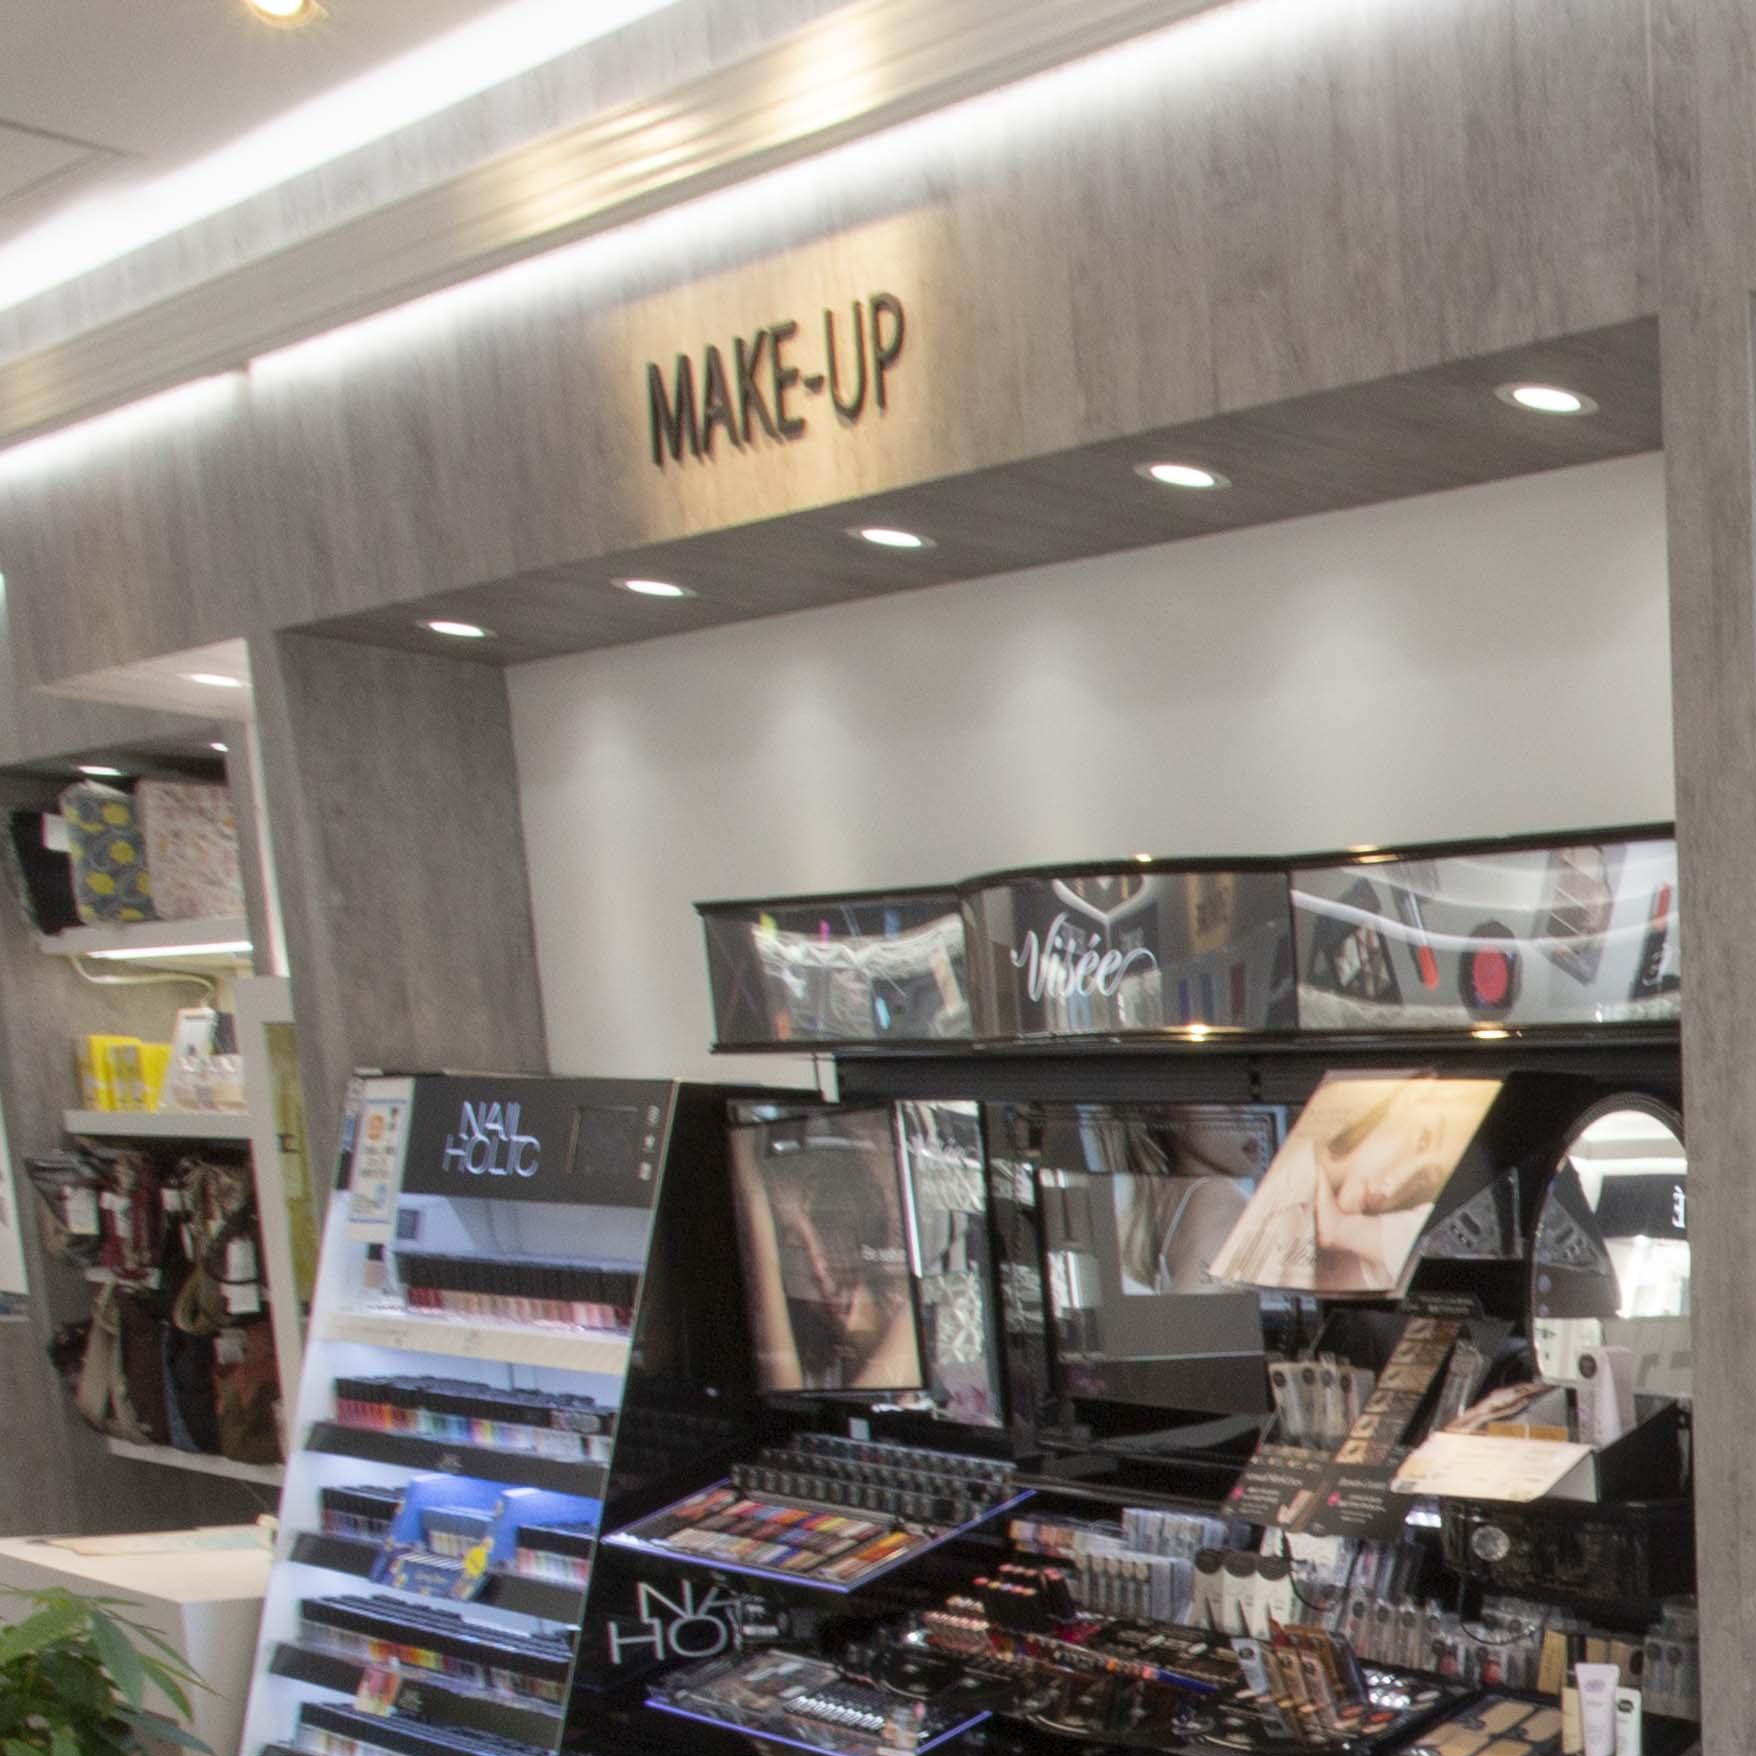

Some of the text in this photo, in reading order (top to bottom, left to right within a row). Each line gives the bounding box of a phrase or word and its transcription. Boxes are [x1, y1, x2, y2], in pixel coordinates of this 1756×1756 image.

[646, 292, 906, 467] MAKE-UP
[459, 1101, 521, 1142] NAIL
[441, 1133, 541, 1178] HOLIC
